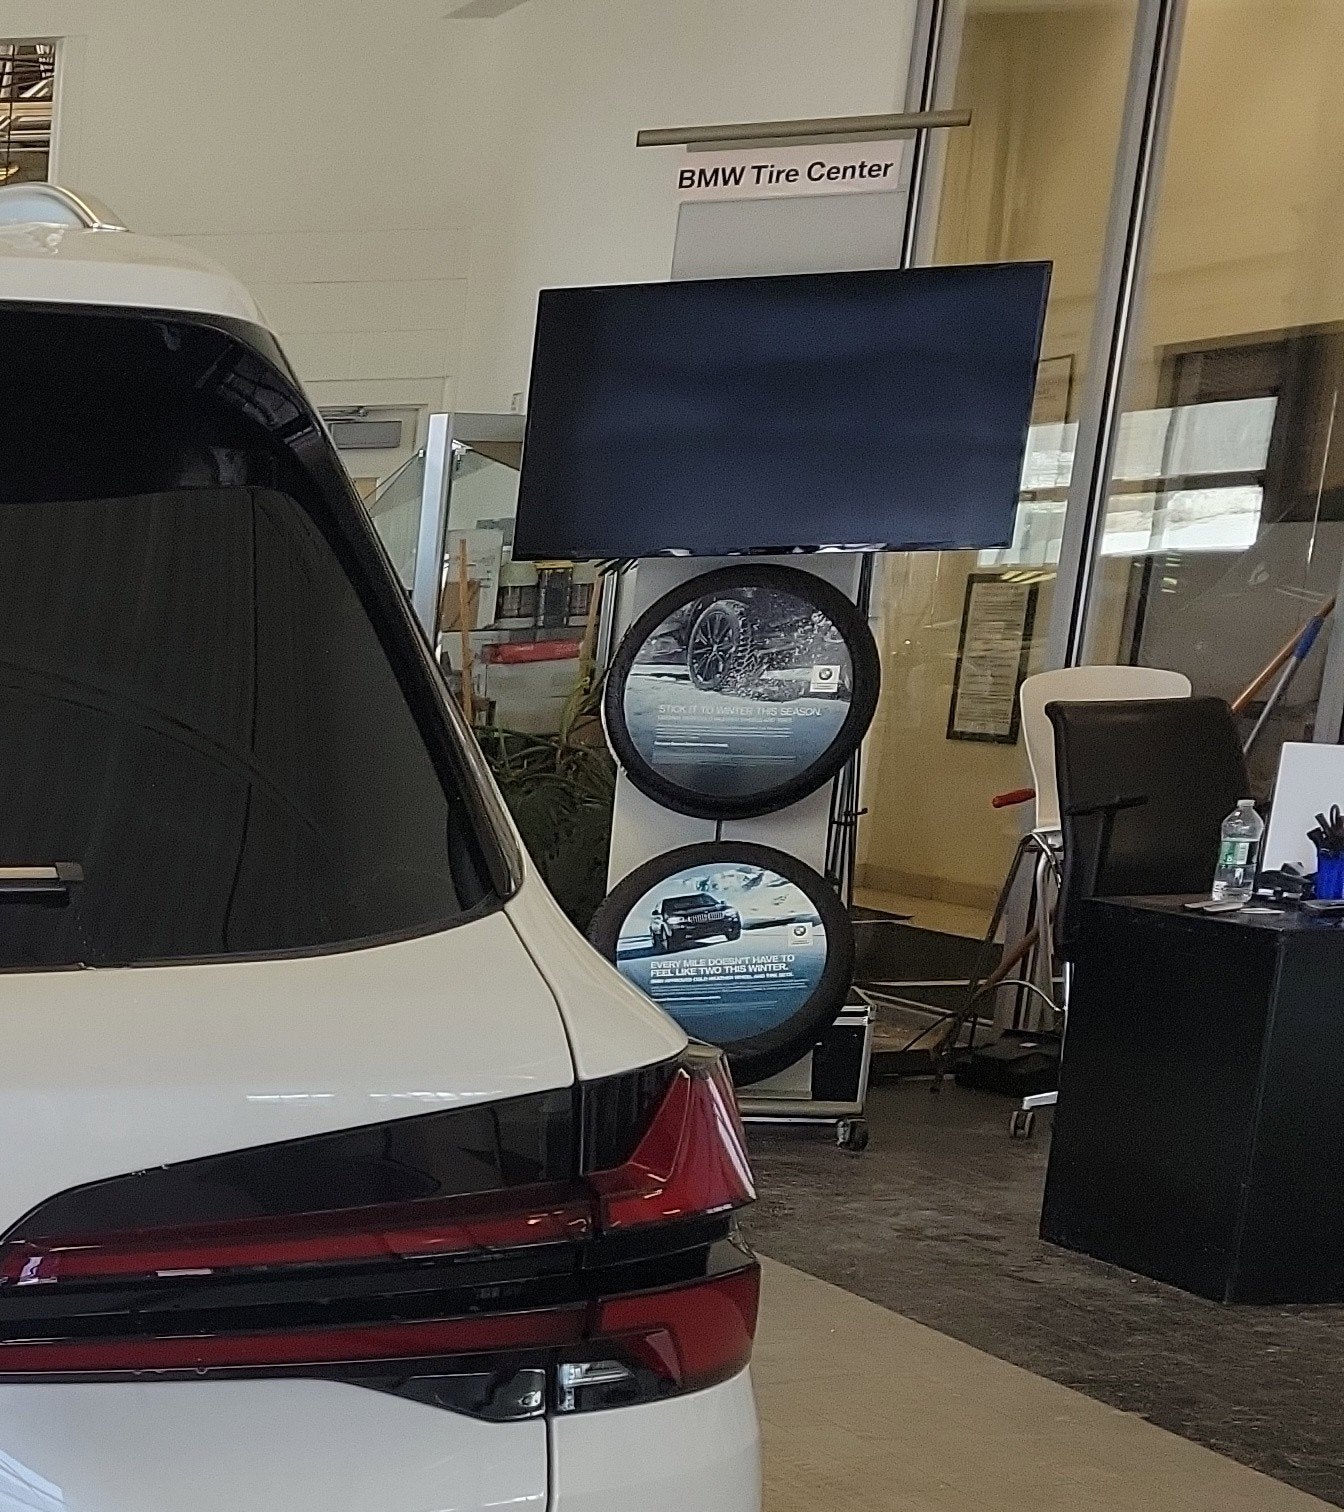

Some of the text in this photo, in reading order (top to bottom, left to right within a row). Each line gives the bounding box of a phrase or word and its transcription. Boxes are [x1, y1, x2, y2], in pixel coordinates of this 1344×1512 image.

[678, 160, 894, 189] BMW Tire Center
[712, 706, 753, 716] WINTER
[757, 707, 778, 716] THIS
[650, 961, 682, 970] EVERY
[683, 958, 706, 968] MILE
[752, 955, 780, 964] HAVE
[781, 954, 795, 963] TO
[650, 968, 674, 978] FEEL
[675, 967, 698, 976] LIKE
[699, 966, 722, 975] TWO
[724, 964, 747, 974] THIS
